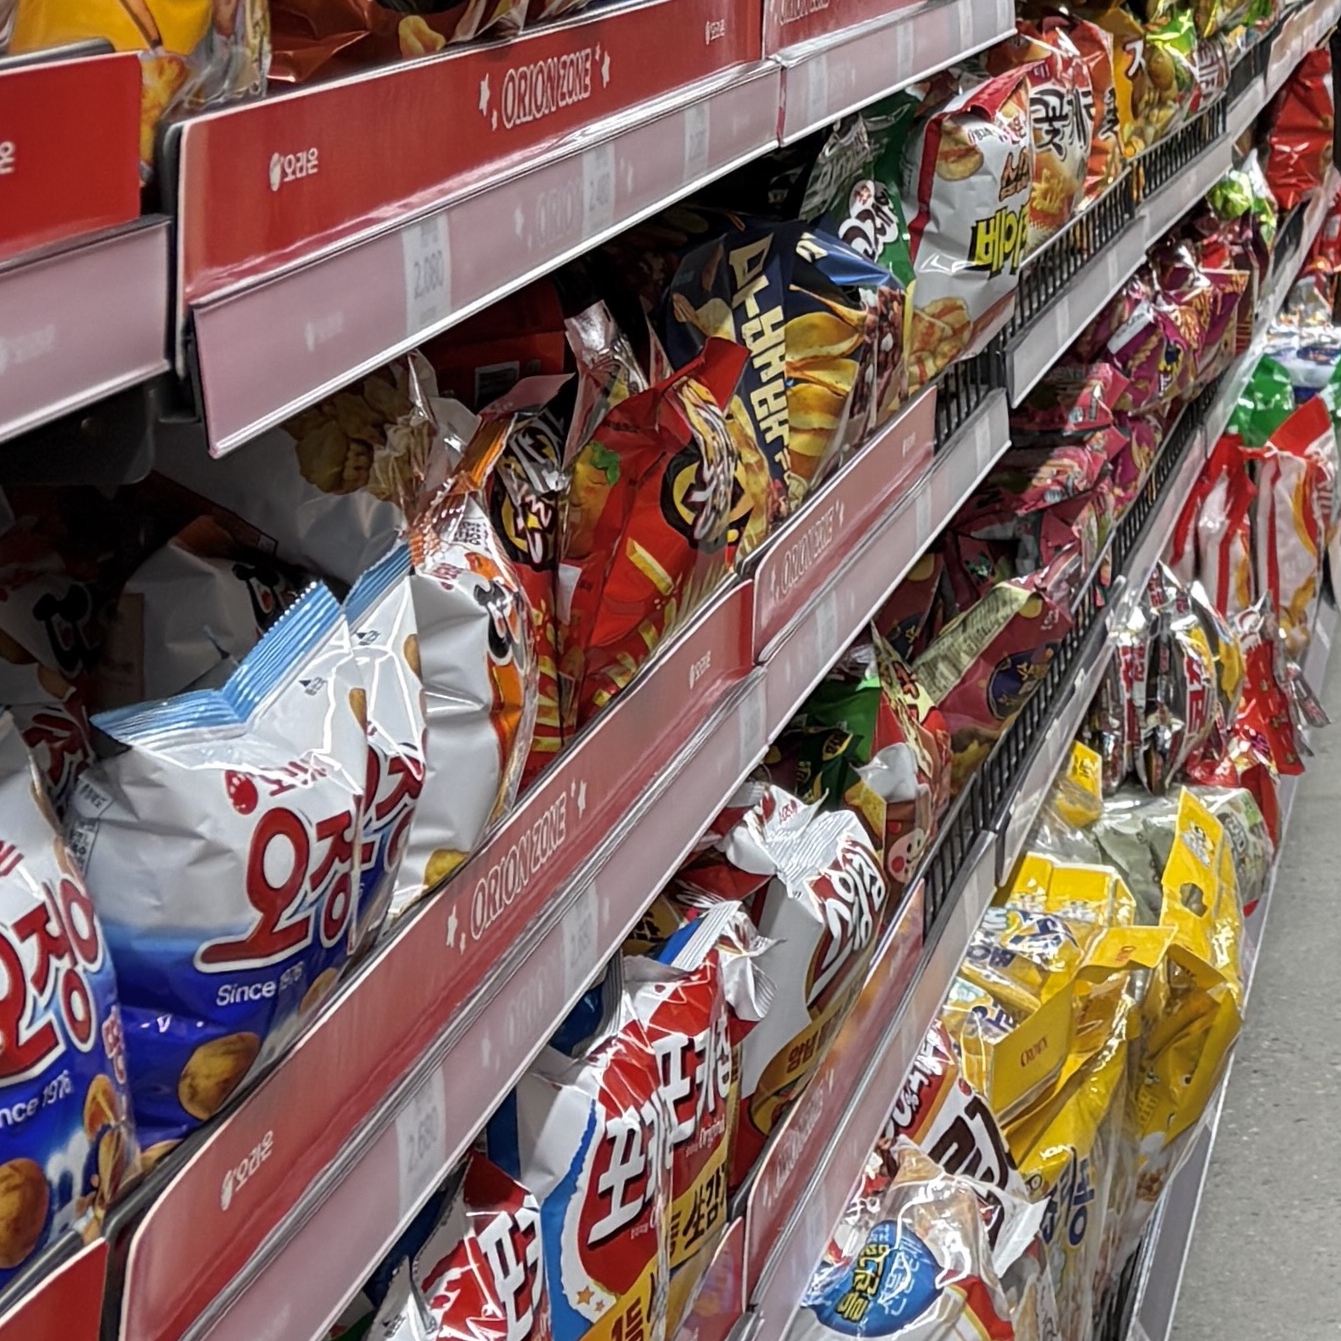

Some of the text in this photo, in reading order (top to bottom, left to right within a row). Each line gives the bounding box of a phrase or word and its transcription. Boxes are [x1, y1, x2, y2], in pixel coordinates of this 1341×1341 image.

[501, 48, 593, 130] ORION ZONE
[283, 147, 319, 180] 오리온
[471, 789, 570, 942] ORION ZONE
[216, 970, 277, 1007] Since
[41, 1068, 74, 1109] 1976
[234, 1129, 274, 1185] 오리온
